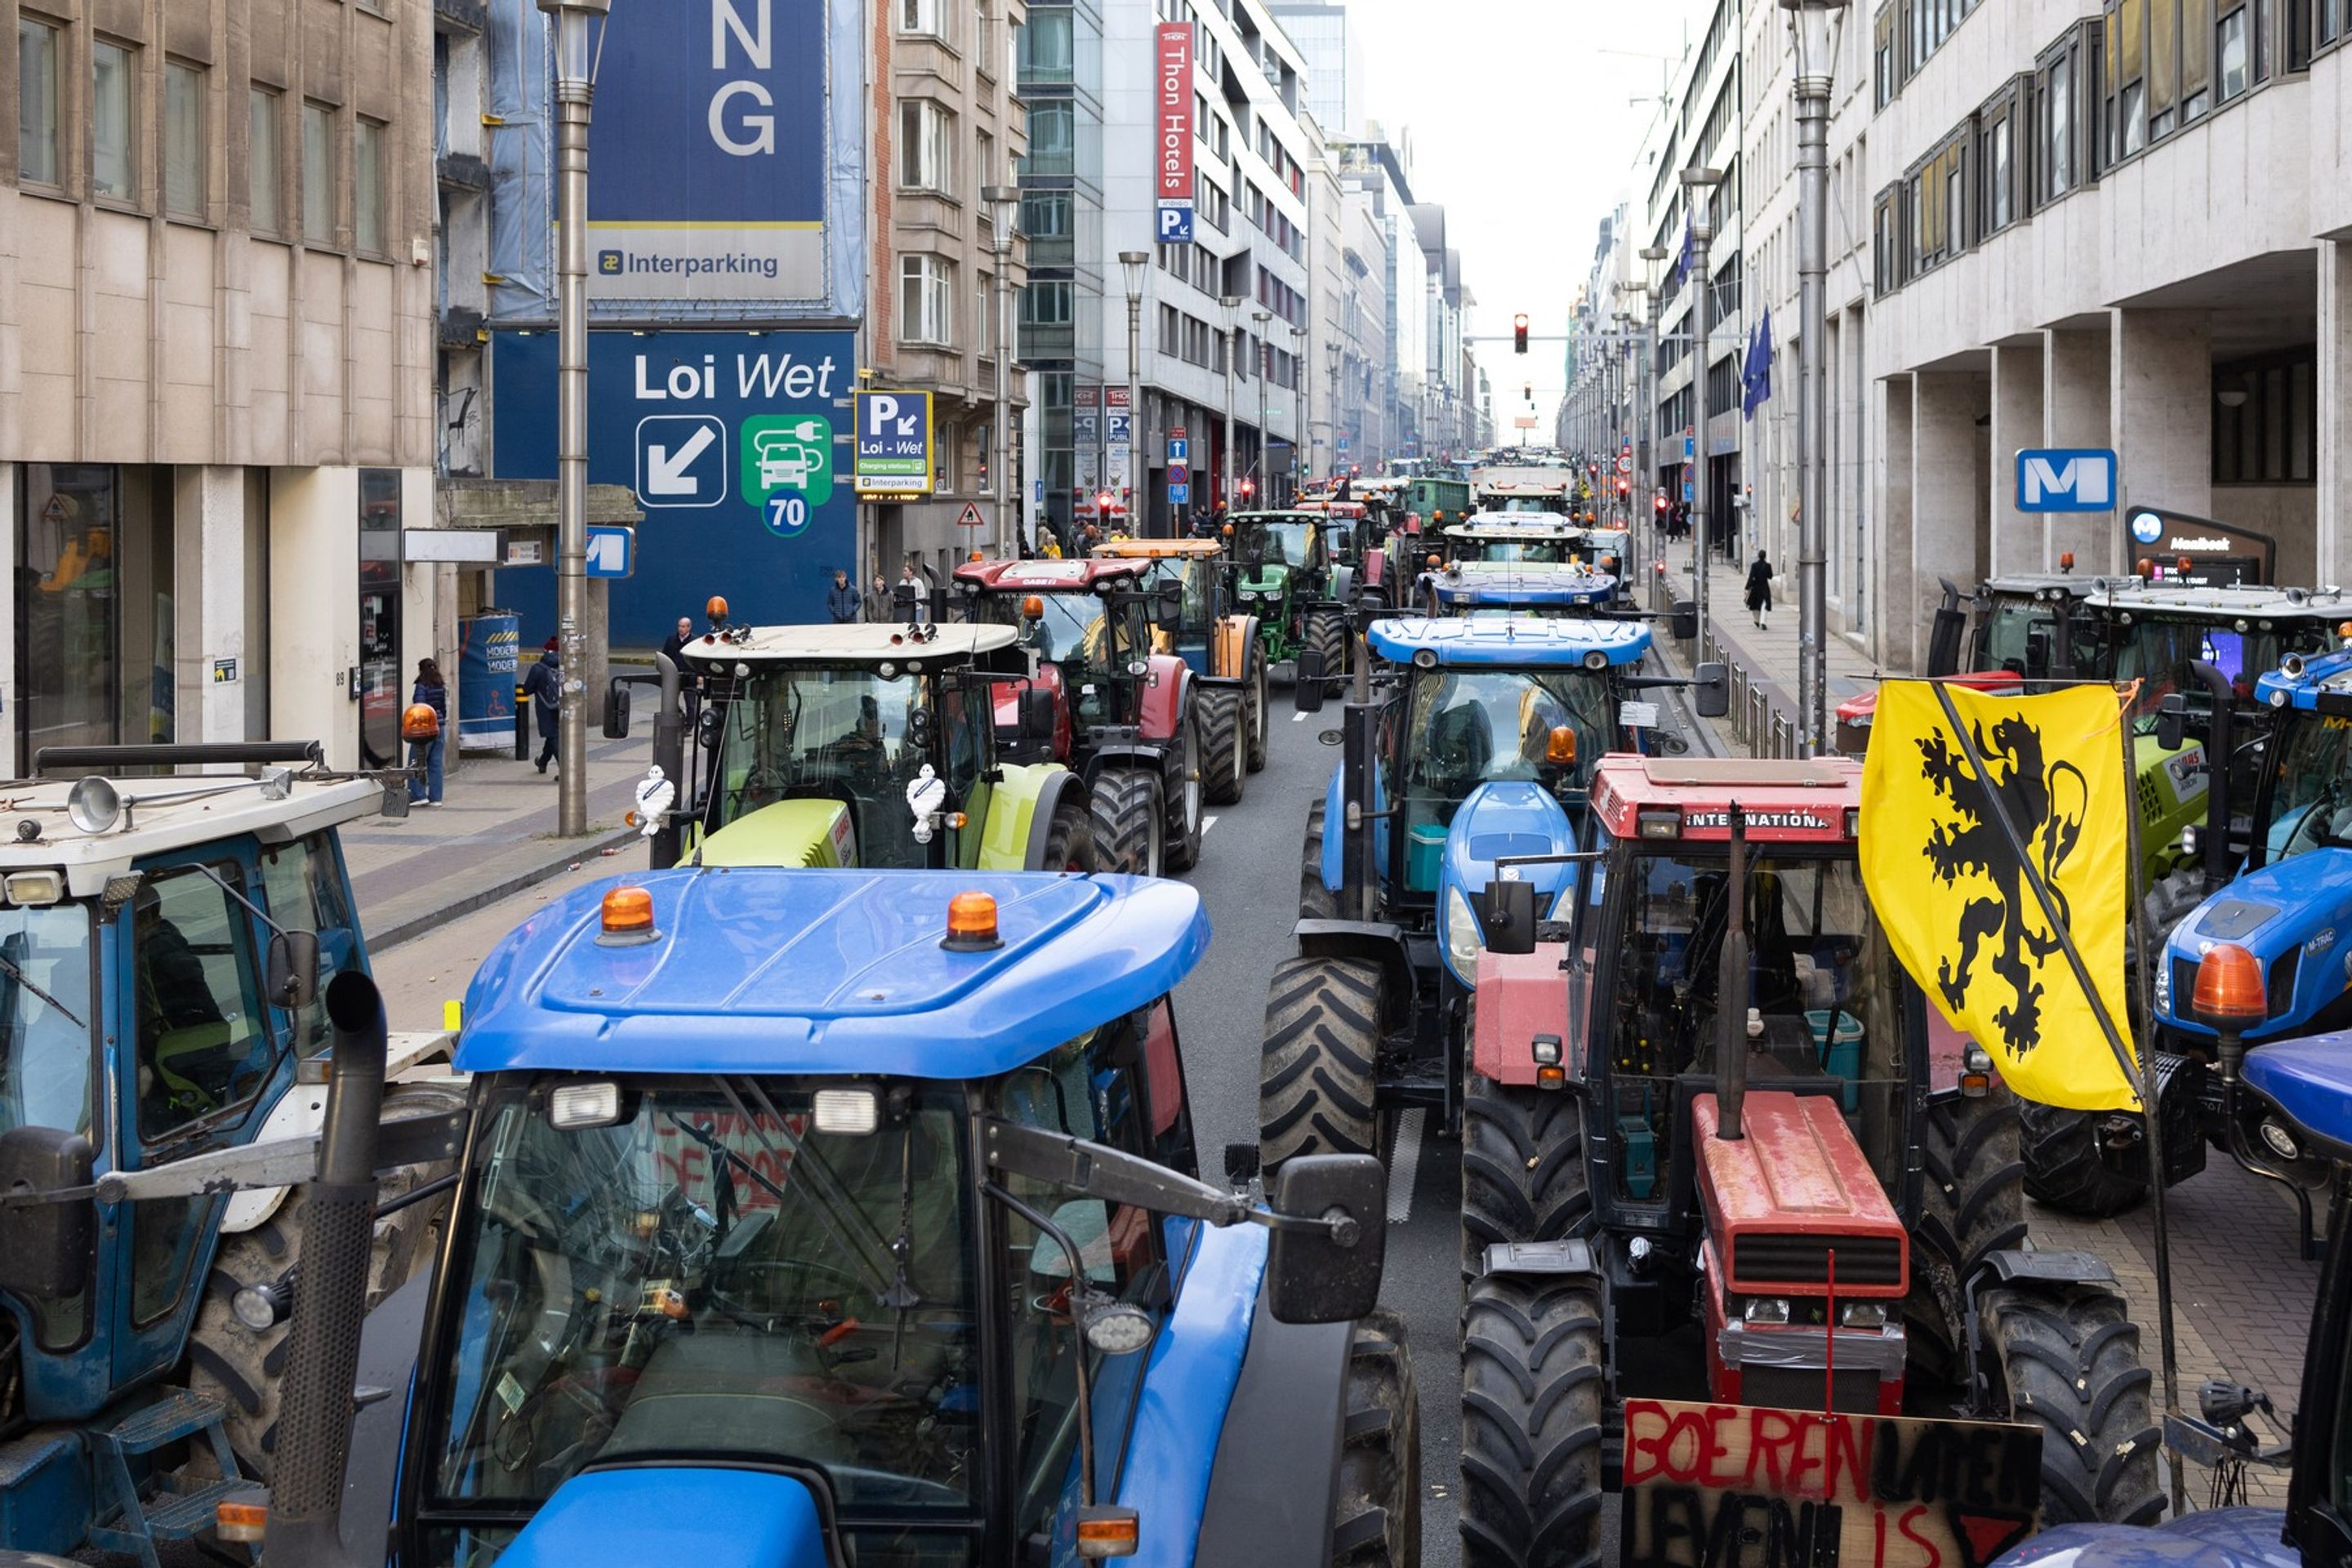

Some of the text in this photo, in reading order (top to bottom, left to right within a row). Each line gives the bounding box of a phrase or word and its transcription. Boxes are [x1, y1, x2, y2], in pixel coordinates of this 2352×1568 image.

[1165, 47, 1185, 188] Thon Hotels
[1161, 210, 1181, 235] P
[628, 252, 777, 278] Interparking
[635, 354, 835, 399] Loi Wet
[871, 395, 898, 434] P
[1109, 417, 1122, 434] P
[861, 441, 883, 454] Loi
[897, 441, 923, 454] Wet
[859, 462, 886, 470] Charging
[872, 479, 922, 488] Interparking
[770, 499, 805, 526] 70
[2170, 537, 2230, 551] Maalbeek
[336, 671, 345, 687] 89
[2307, 930, 2334, 952] M-TRAC
[1624, 1400, 2042, 1508] BOEREN LATEN
